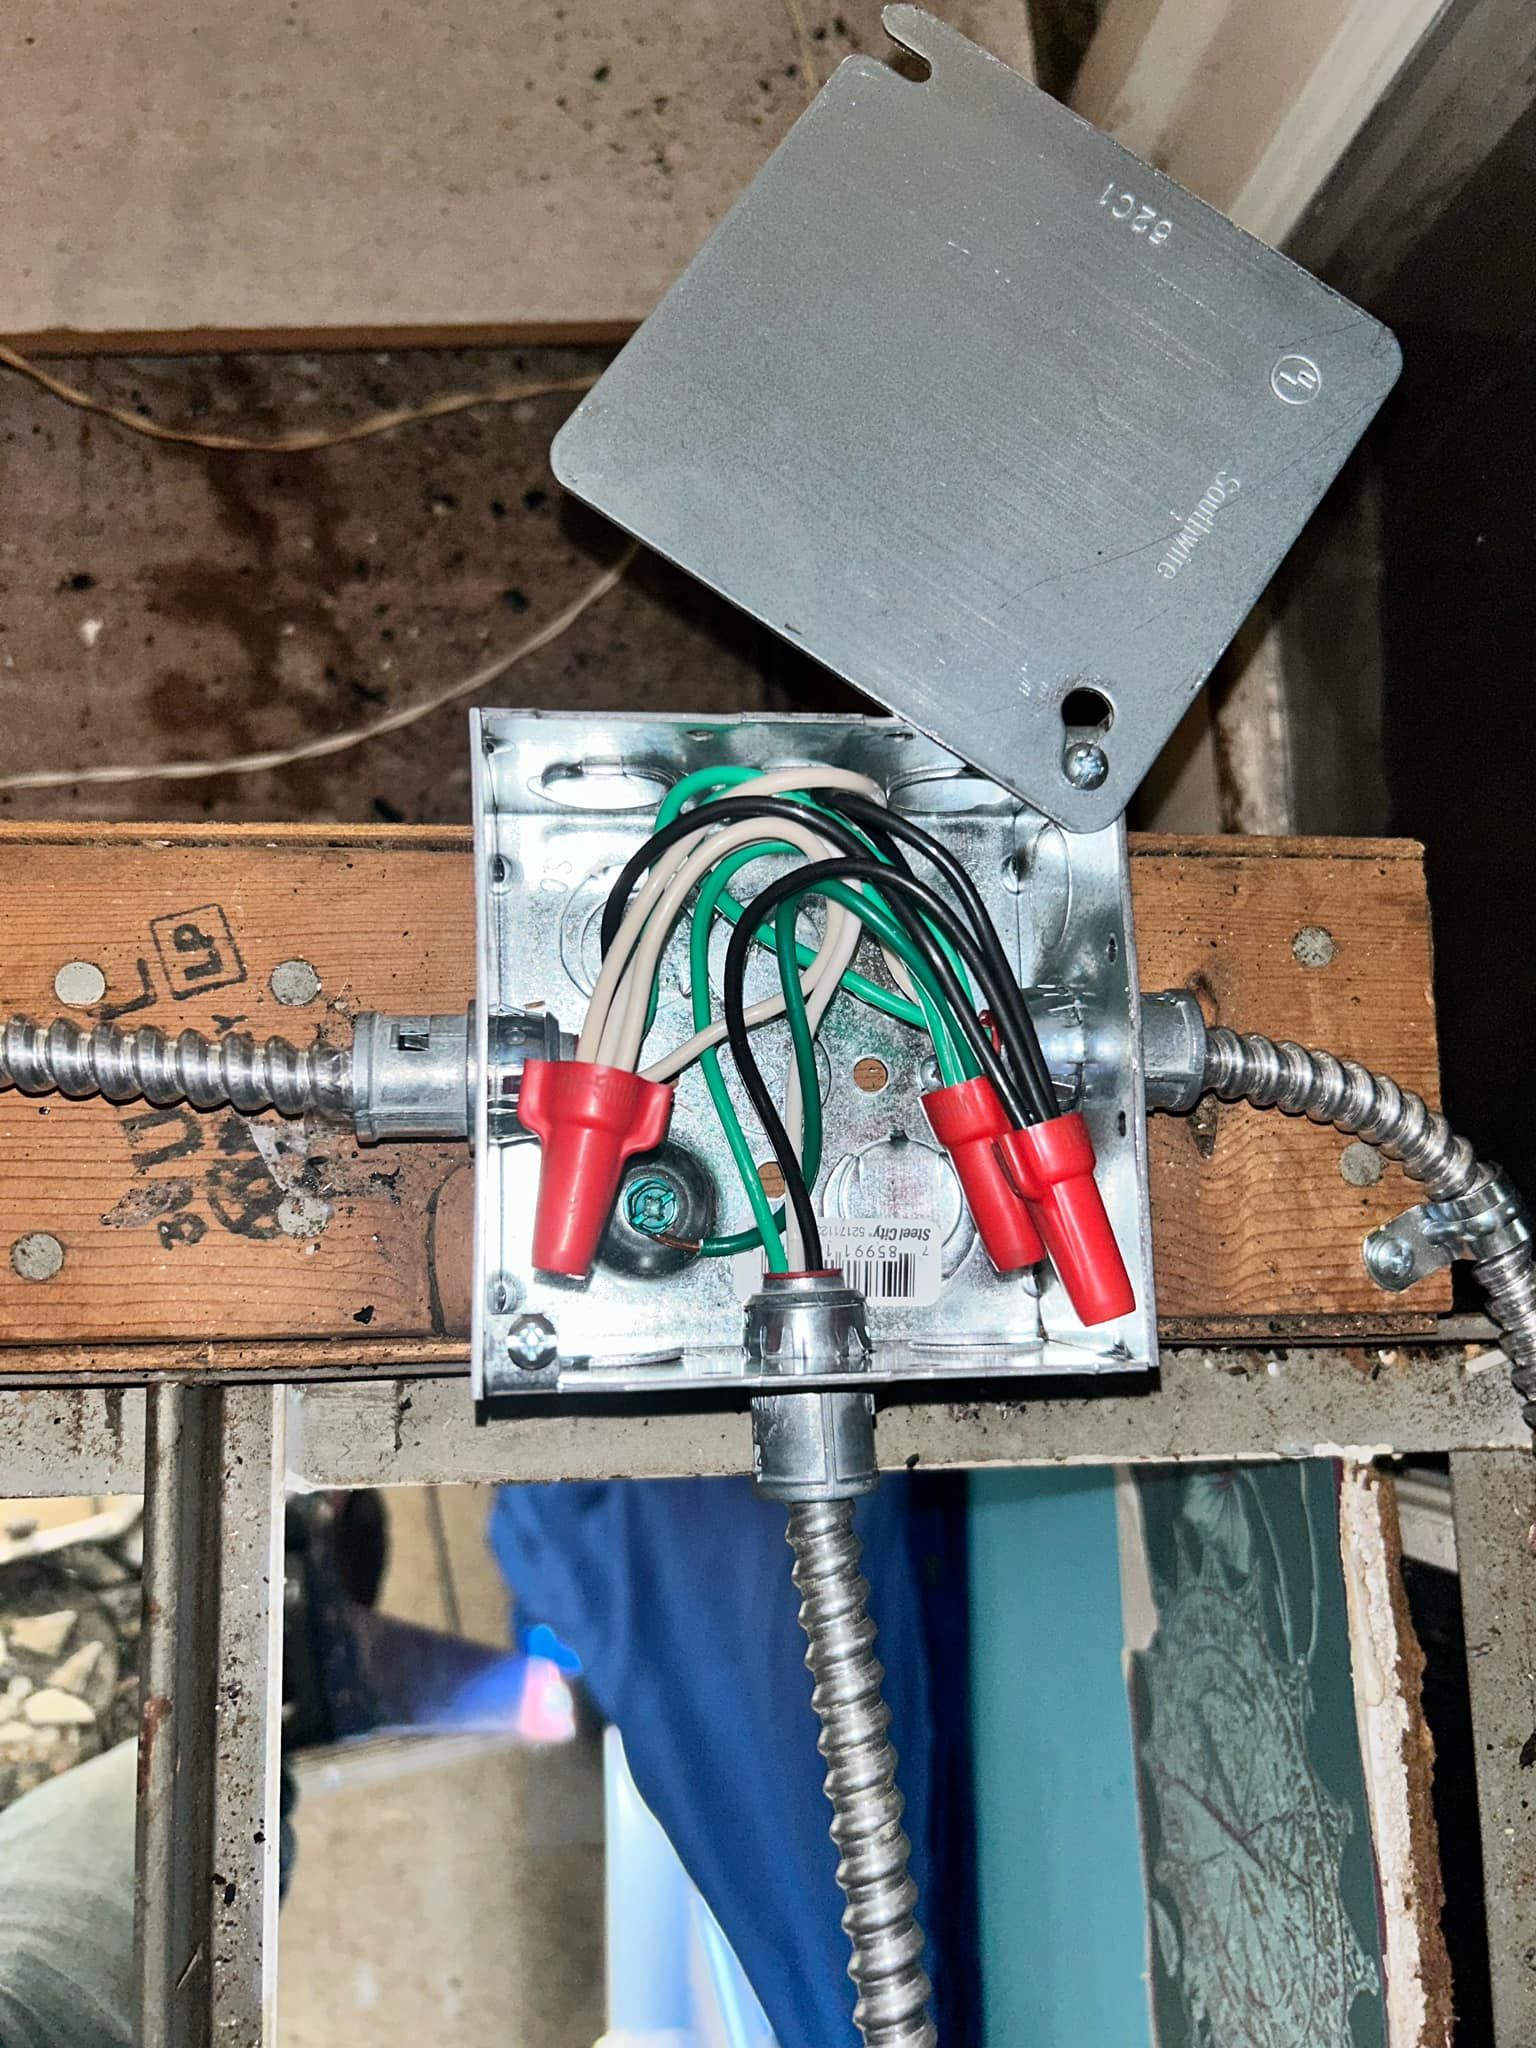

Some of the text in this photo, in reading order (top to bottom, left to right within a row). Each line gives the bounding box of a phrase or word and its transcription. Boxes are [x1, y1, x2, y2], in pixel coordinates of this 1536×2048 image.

[1157, 471, 1240, 579] Southwire
[898, 1227, 931, 1241] Steel
[843, 1245, 898, 1258] 85991
[922, 1246, 929, 1256] 7
